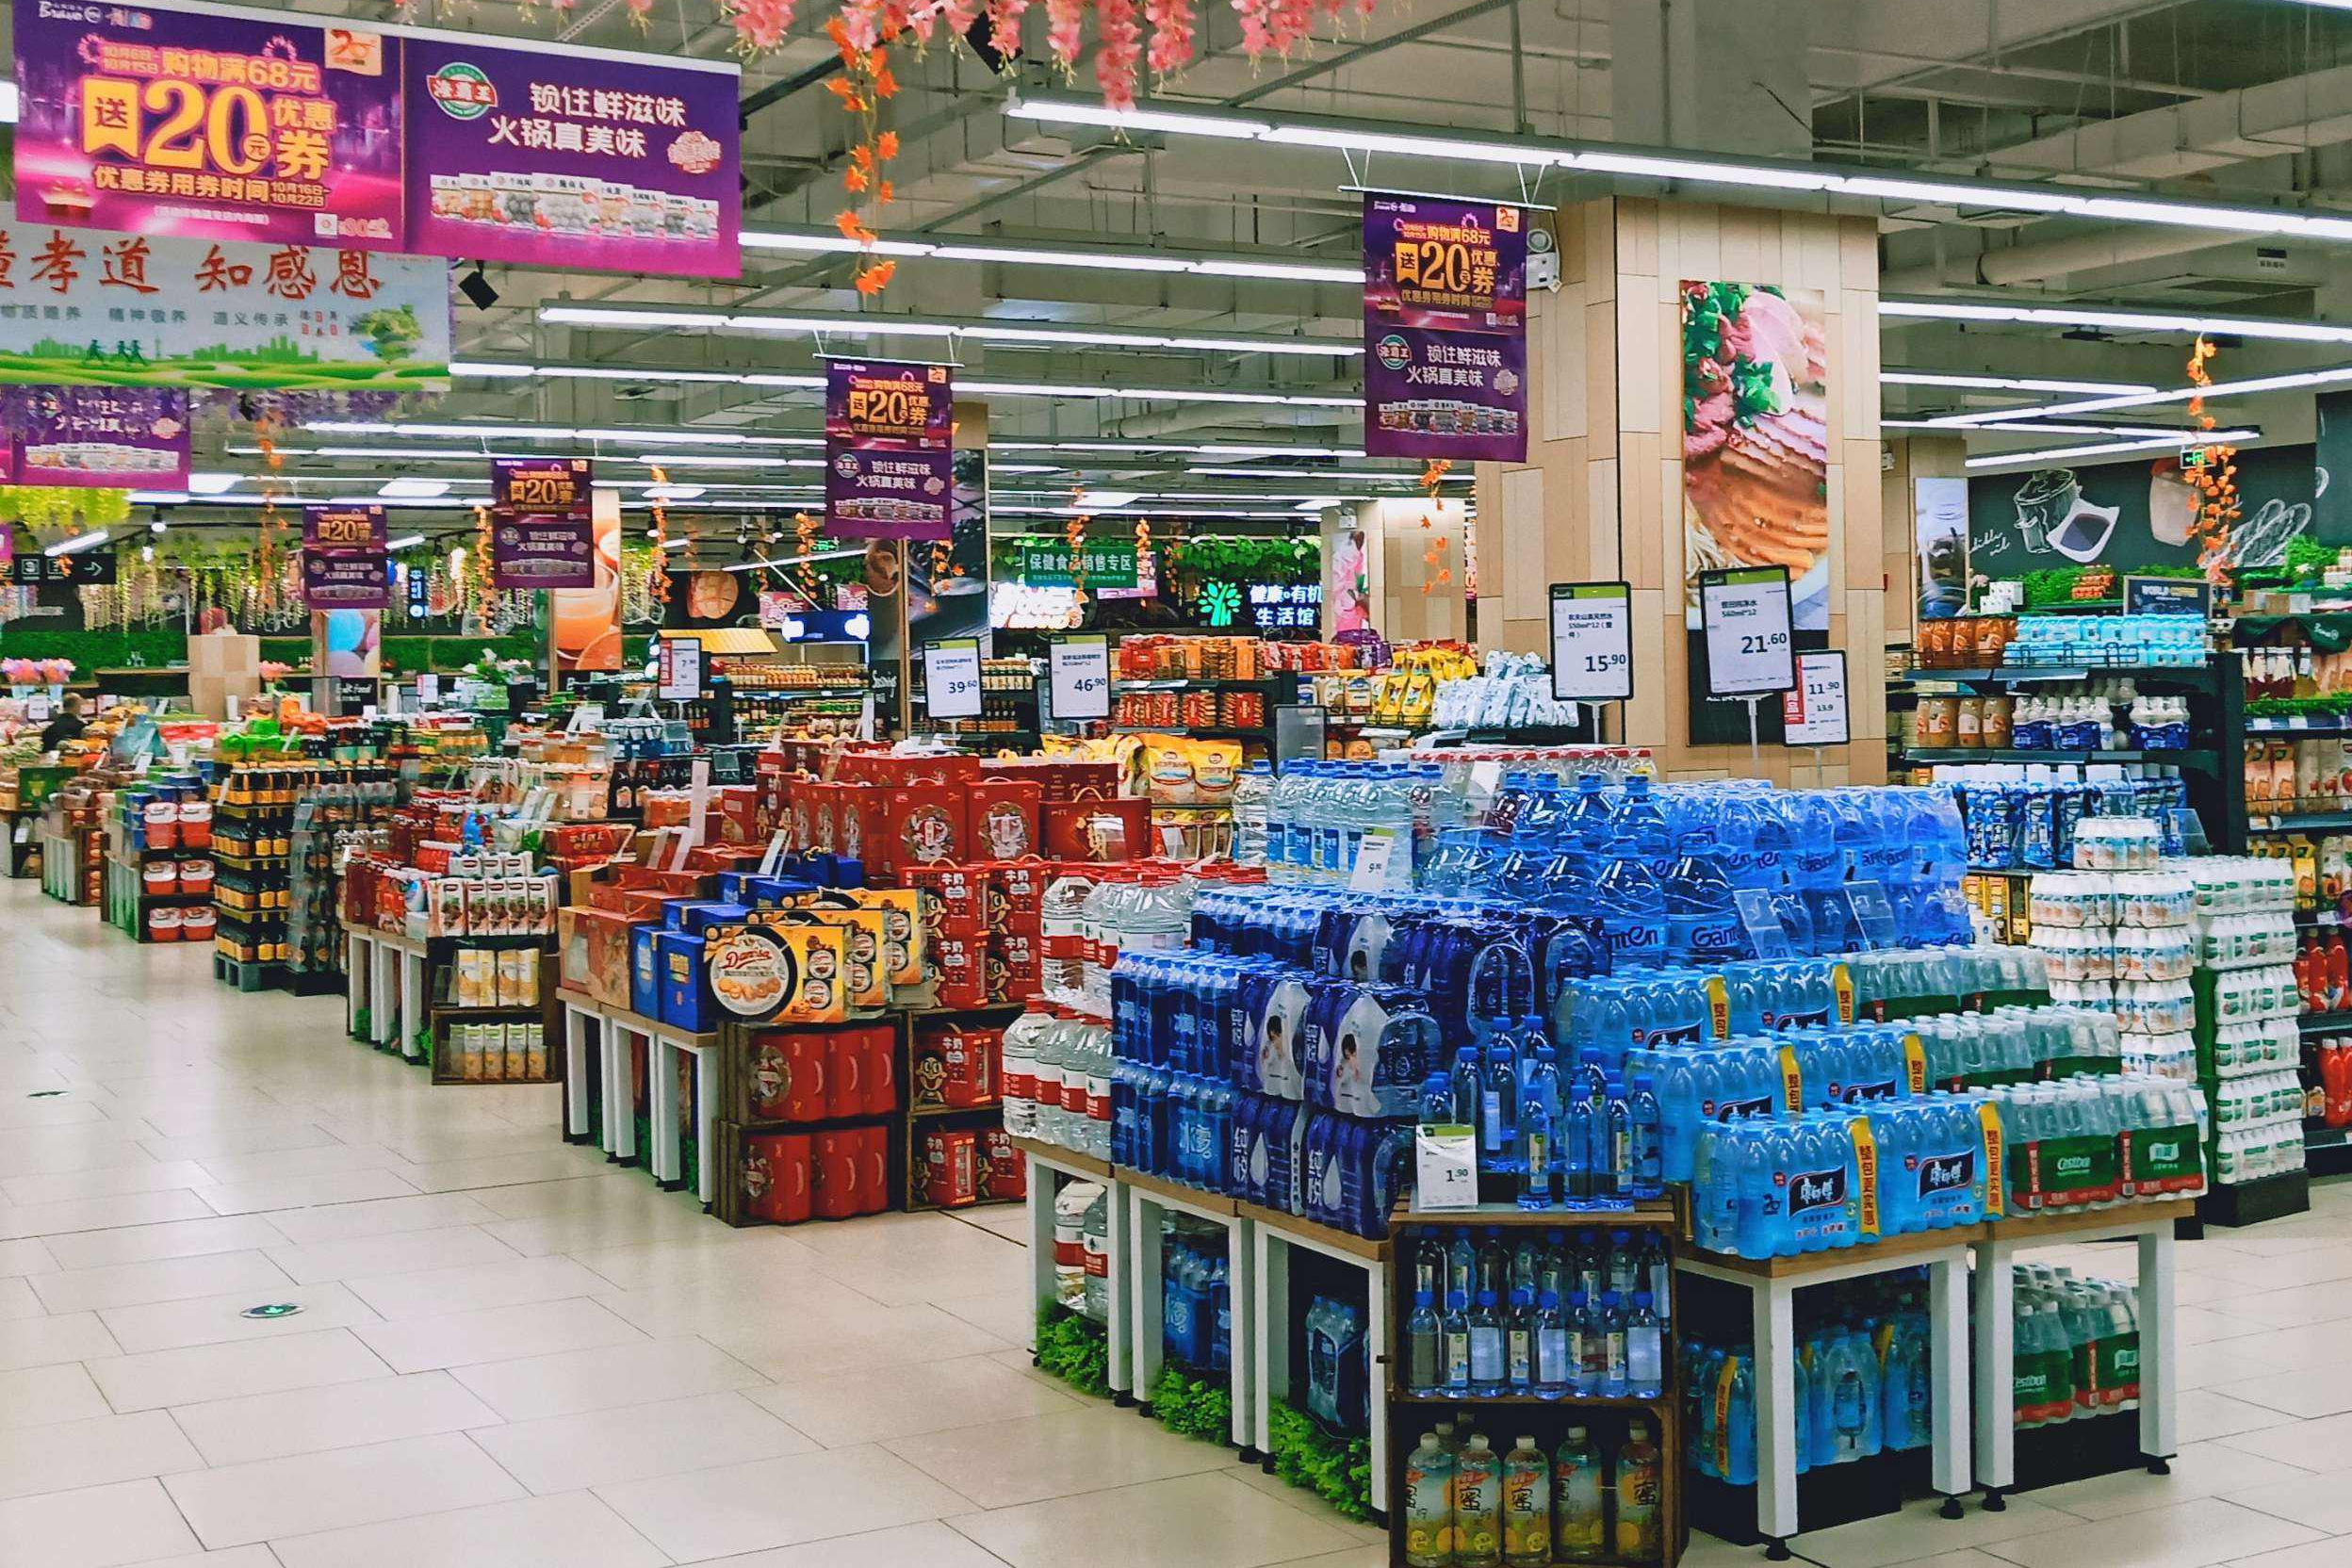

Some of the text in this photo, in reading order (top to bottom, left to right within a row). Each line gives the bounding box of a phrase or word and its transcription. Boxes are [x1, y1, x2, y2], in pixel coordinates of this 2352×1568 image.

[162, 51, 318, 90] 购物满68元
[94, 98, 129, 128] 送
[273, 99, 335, 132] 优惠
[530, 82, 686, 127] 锁住鲜滋味
[145, 79, 267, 173] 20
[488, 115, 647, 158] 火锅真美味
[277, 130, 330, 179] 券
[95, 166, 270, 204] 优惠券用券时间
[195, 244, 386, 301] 知感恩
[1421, 241, 1470, 292] 20
[1406, 365, 1484, 387] 火锅真美味
[868, 390, 908, 424] 20
[526, 480, 557, 503] 20
[1254, 607, 1315, 626] 生活馆
[1740, 632, 1788, 654] 21.60
[1584, 654, 1626, 673] 15.90
[1073, 678, 1106, 692] 46.90
